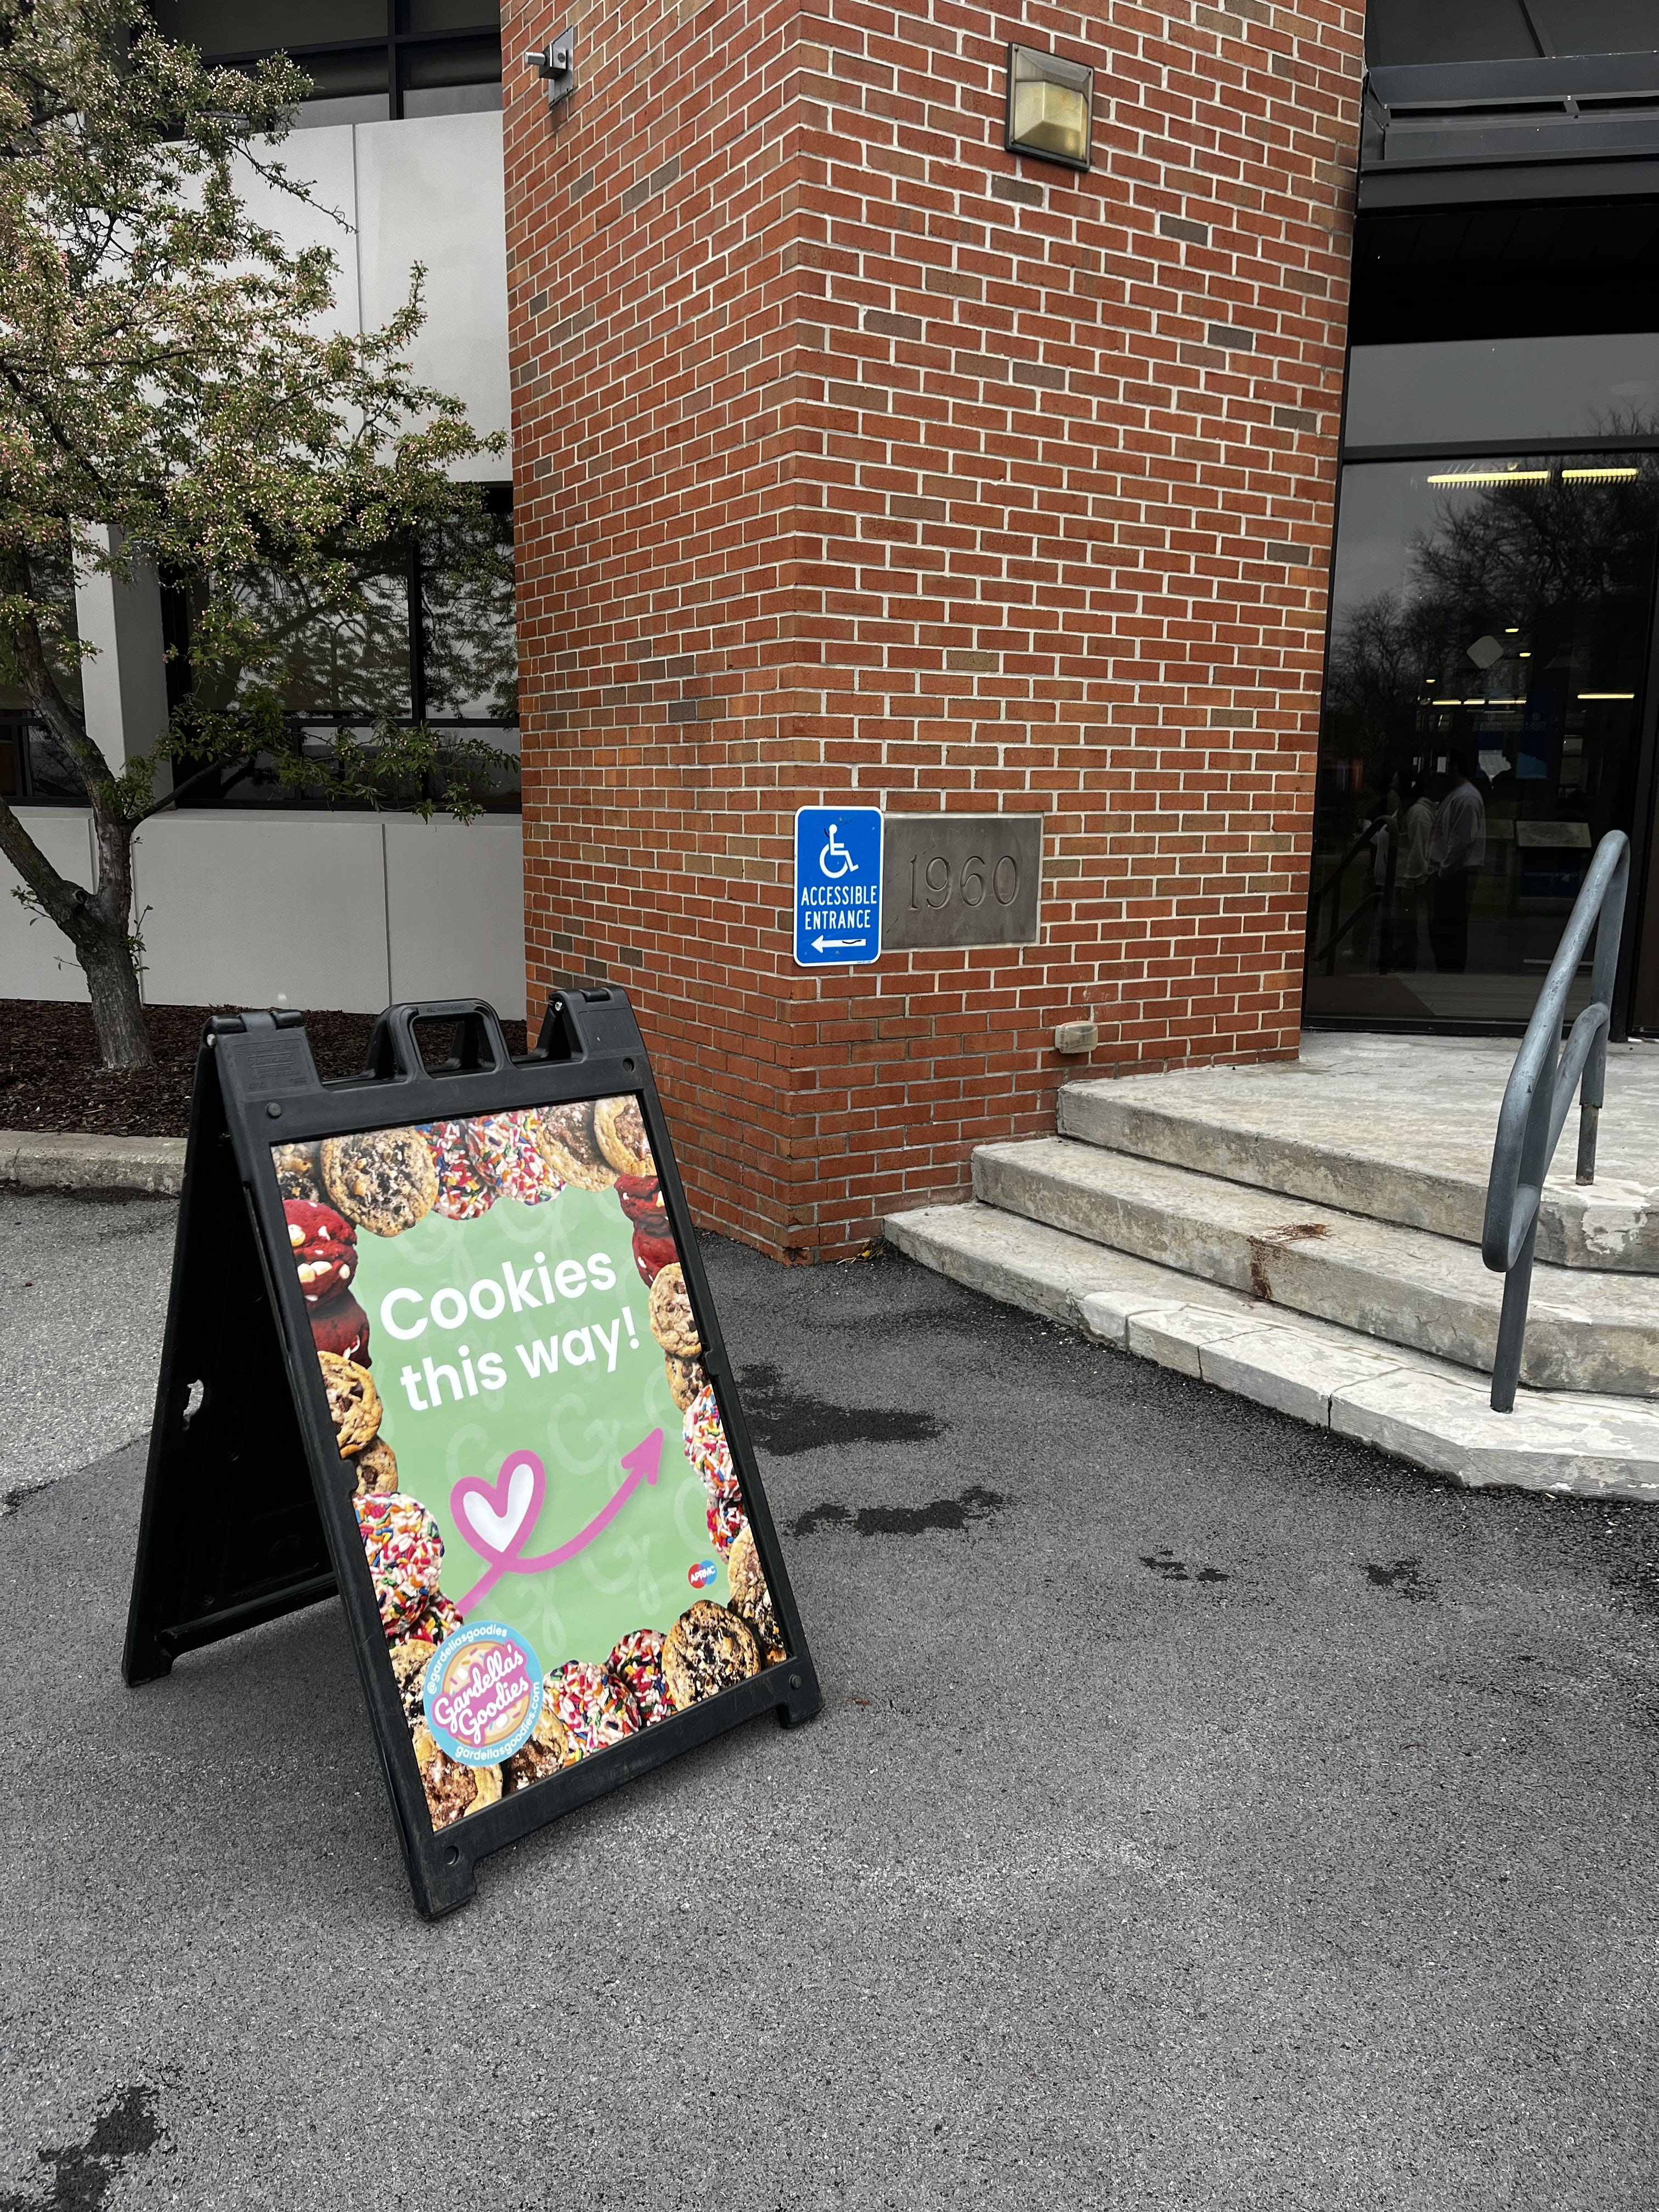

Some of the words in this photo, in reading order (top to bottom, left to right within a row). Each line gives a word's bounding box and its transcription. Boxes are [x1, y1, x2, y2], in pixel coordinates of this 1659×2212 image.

[801, 885, 878, 906] ACCESSIBLE
[908, 854, 1020, 911] 1960
[805, 909, 871, 931] ENTRANCE
[380, 1251, 617, 1340] Cookies
[399, 1345, 507, 1411] this
[515, 1306, 640, 1379] way!
[427, 1624, 507, 1695] @gardellasgoodies
[434, 1644, 523, 1734] Gardella's
[455, 1681, 540, 1760] gardellasgoodies.com
[458, 1676, 529, 1745] Goodies
